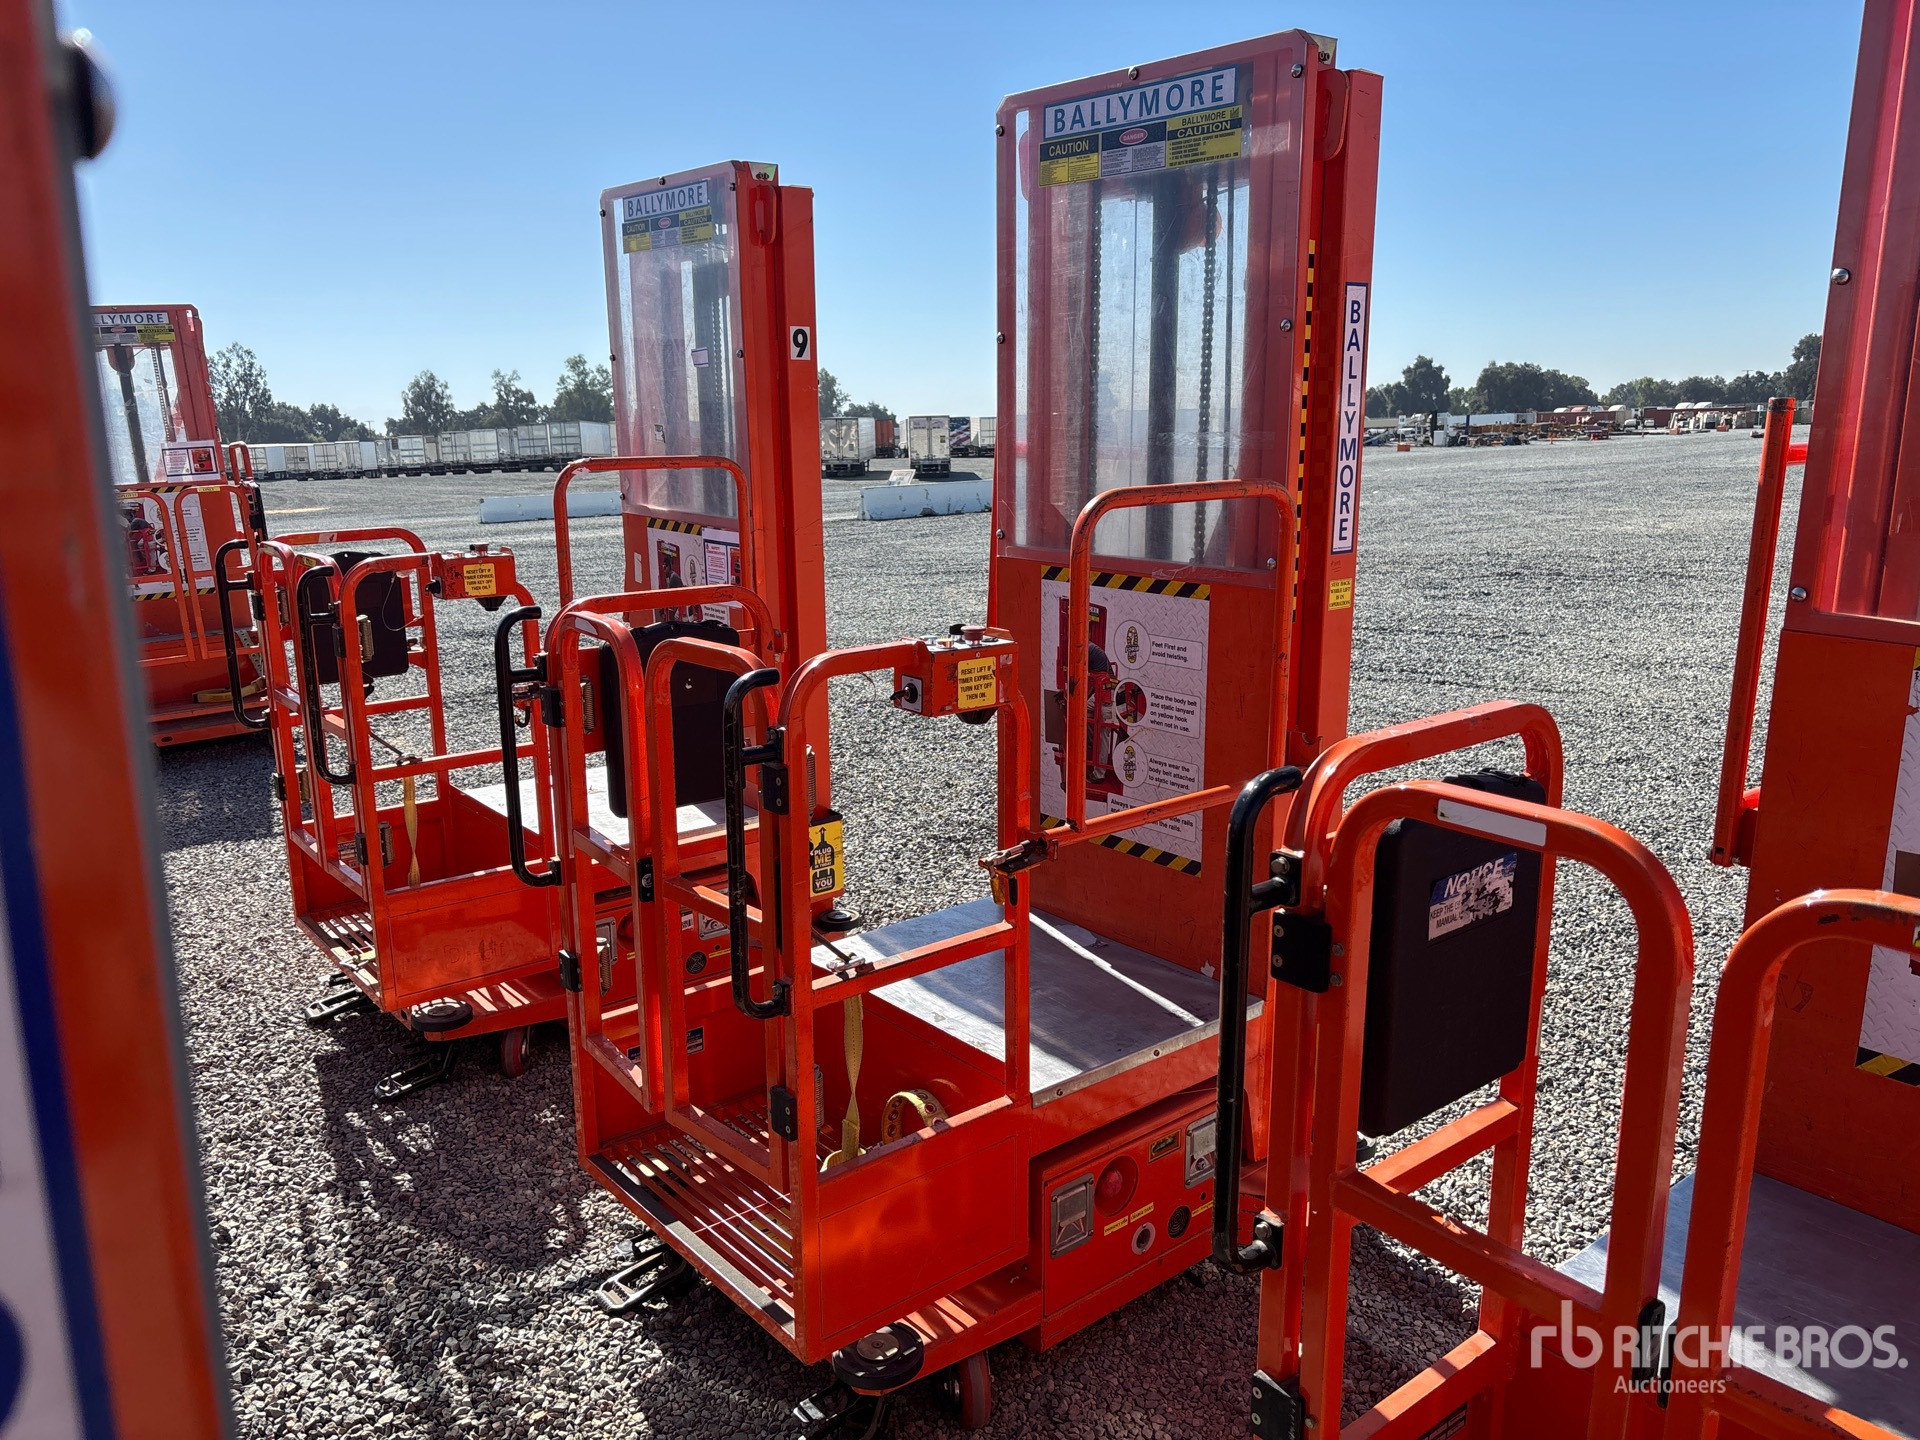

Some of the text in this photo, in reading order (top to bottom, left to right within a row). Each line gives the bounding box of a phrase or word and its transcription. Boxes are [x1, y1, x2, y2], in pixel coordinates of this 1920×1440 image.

[1054, 74, 1224, 133] BALLYMORE
[1181, 110, 1226, 126] BALLYMORE
[1177, 120, 1231, 138] CAUTION
[1123, 132, 1144, 141] DANGER
[1049, 140, 1089, 157] CAUTION
[627, 185, 703, 217] BALLYMORE
[793, 328, 808, 358] 9
[1339, 299, 1361, 541] BALLYMORE
[1164, 642, 1176, 651] First
[1167, 653, 1188, 663] twisting.
[961, 667, 975, 675] RESET
[977, 665, 986, 673] LIFT
[974, 683, 983, 691] KEY
[1151, 692, 1164, 700] Place
[1174, 697, 1186, 706] body
[1187, 699, 1197, 707] belt
[1158, 711, 1173, 720] yellow
[1175, 714, 1187, 723] hook
[1175, 706, 1194, 716] lanyard
[1150, 719, 1163, 727] when
[1149, 757, 1167, 768] Always
[1149, 767, 1161, 775] body
[1173, 772, 1195, 783] attached
[1155, 776, 1168, 784] static
[1170, 778, 1190, 790] lanyard.
[1111, 798, 1128, 808] Always
[1169, 824, 1181, 832] rails.
[1181, 819, 1193, 827] rails
[814, 846, 832, 856] PLUG
[814, 852, 832, 866] ME
[815, 878, 832, 888] YOU
[1443, 858, 1504, 898] NOTICE
[1430, 907, 1443, 919] KEEP
[1444, 903, 1453, 914] THE
[1436, 912, 1458, 928] MANUAL
